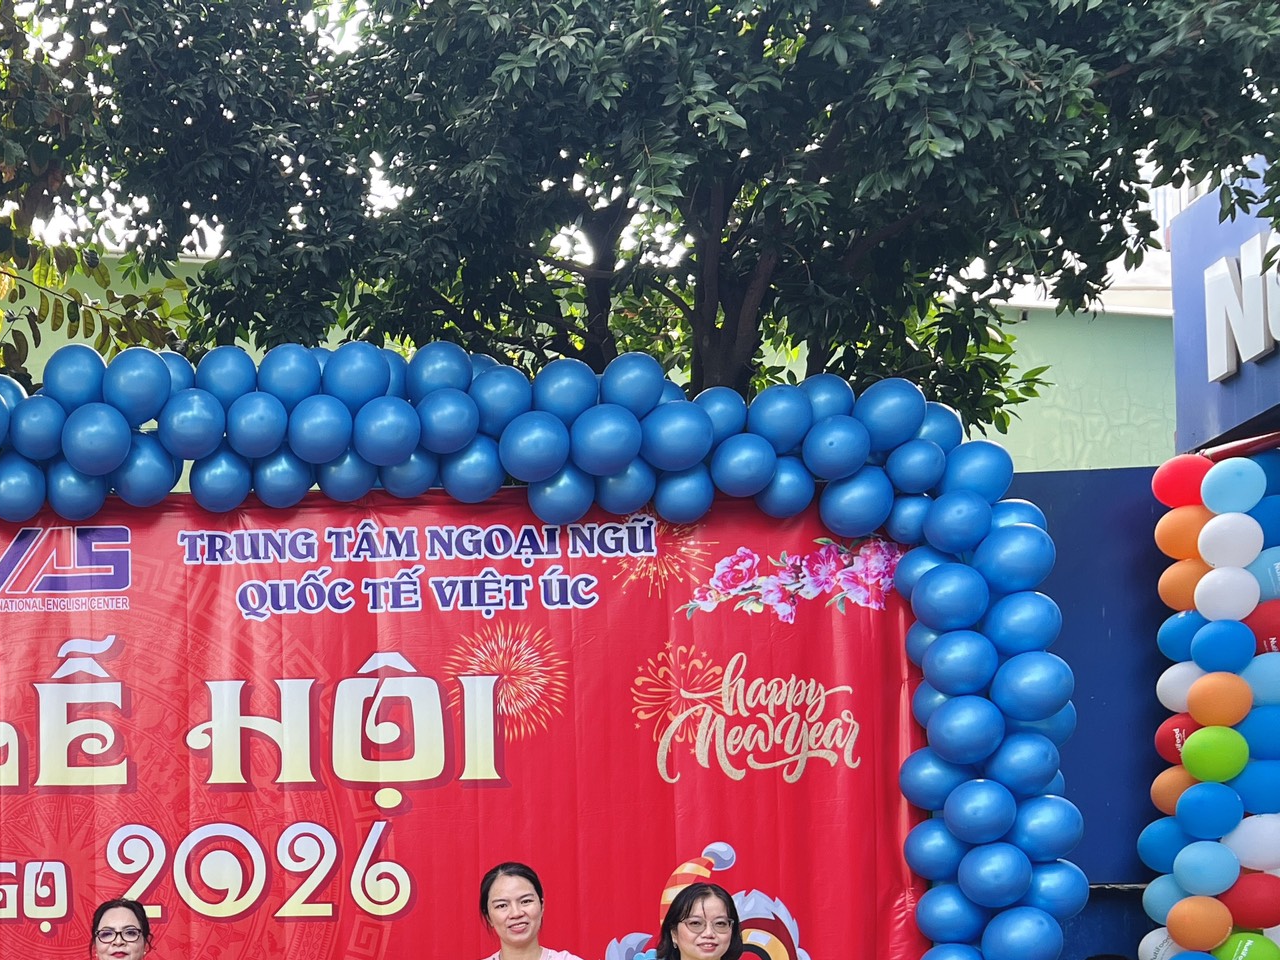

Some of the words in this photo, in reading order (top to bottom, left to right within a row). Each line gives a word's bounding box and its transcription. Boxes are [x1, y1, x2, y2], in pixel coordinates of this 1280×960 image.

[1204, 231, 1280, 383] N
[179, 529, 317, 564] TRUNG
[325, 522, 419, 561] TÂM
[426, 525, 562, 567] NGOẠI
[569, 515, 656, 557] NGỮ
[46, 598, 87, 612] ENGLISH
[89, 597, 129, 610] CENTER
[237, 569, 354, 621] QUỐC
[362, 566, 422, 612] TẾ
[431, 567, 531, 618] VIỆT
[541, 565, 599, 609] ÚC
[680, 652, 853, 722] happy
[186, 651, 502, 809] HỘI
[657, 703, 773, 783] New
[747, 709, 861, 783] Year
[105, 822, 412, 919] 2026
